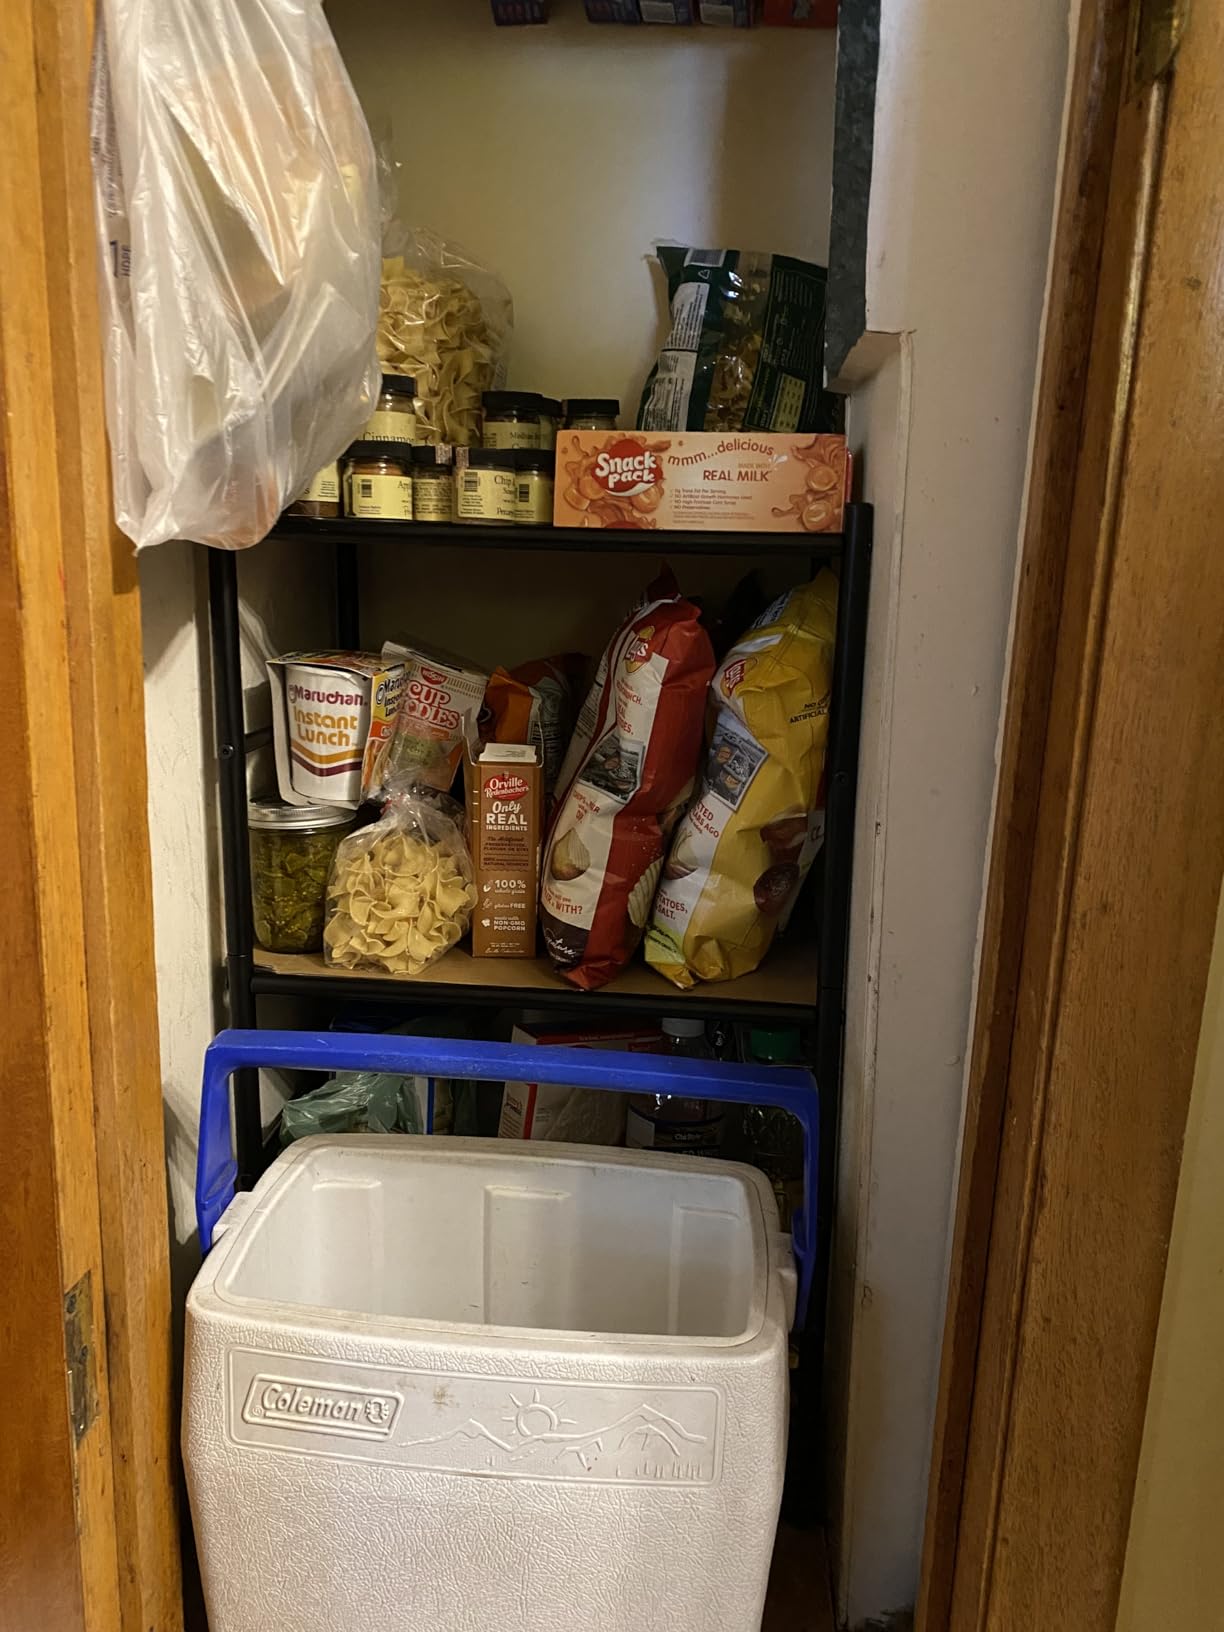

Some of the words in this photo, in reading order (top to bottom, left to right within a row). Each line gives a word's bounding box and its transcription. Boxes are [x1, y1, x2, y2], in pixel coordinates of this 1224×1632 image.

[595, 451, 657, 477] Snack
[608, 469, 655, 488] pack
[703, 470, 732, 481] REAL
[737, 470, 771, 482] MILK
[294, 684, 364, 706] Maruchan
[409, 681, 451, 708] CUP
[294, 706, 358, 729] Instant
[404, 698, 460, 729] ODLES
[297, 725, 350, 747] Lunch
[489, 777, 523, 790] Orville
[492, 801, 521, 813] Only
[486, 813, 527, 825] REAL
[704, 823, 720, 838] AGO
[494, 879, 526, 889] 100%
[556, 902, 583, 914] WITH?
[262, 1383, 363, 1421] Coleman
